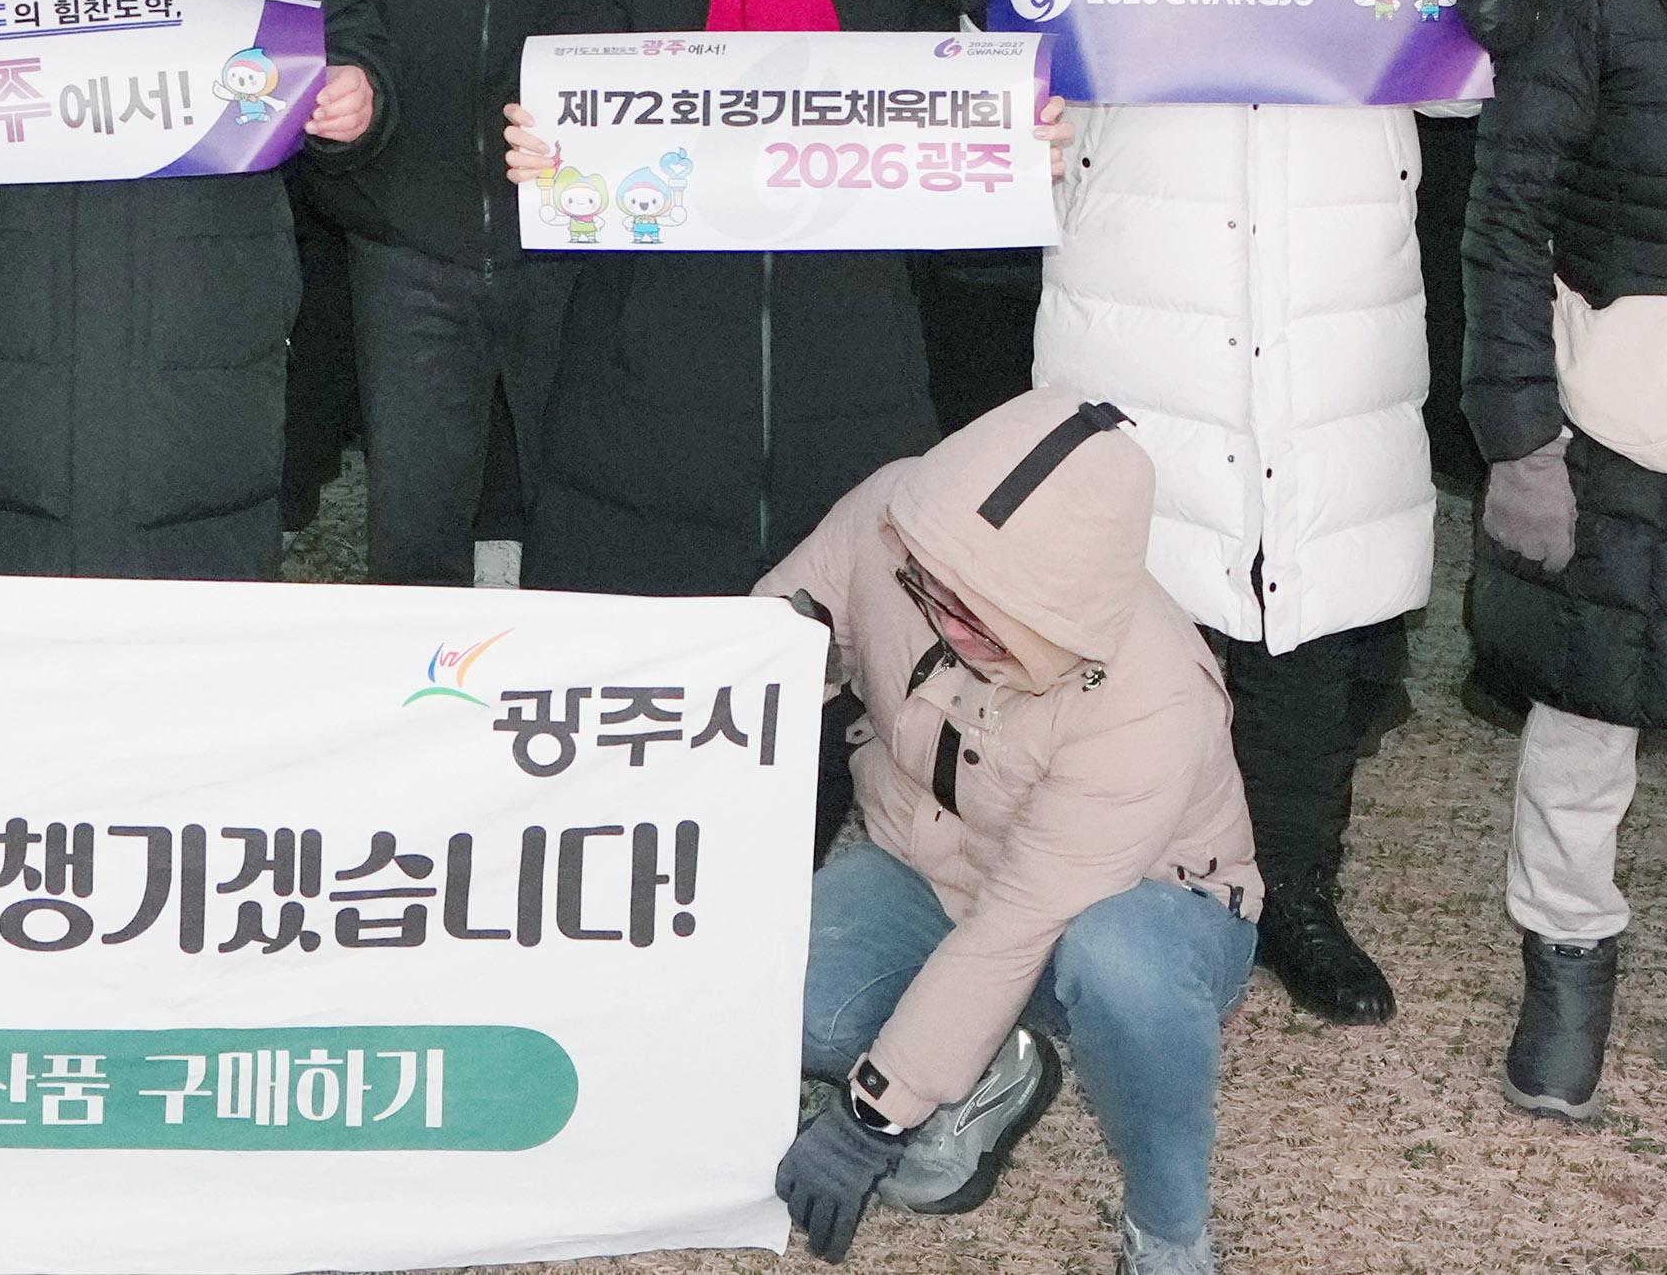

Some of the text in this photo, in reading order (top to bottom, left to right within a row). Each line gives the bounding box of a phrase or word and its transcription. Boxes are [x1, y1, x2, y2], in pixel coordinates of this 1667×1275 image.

[54, 0, 183, 25] 힘찬도약,
[558, 90, 1011, 128] 제72회 경기도체육대회
[766, 142, 1013, 193] 2026 광주
[492, 683, 780, 778] 광주시
[144, 1048, 443, 1128] 구매하기
